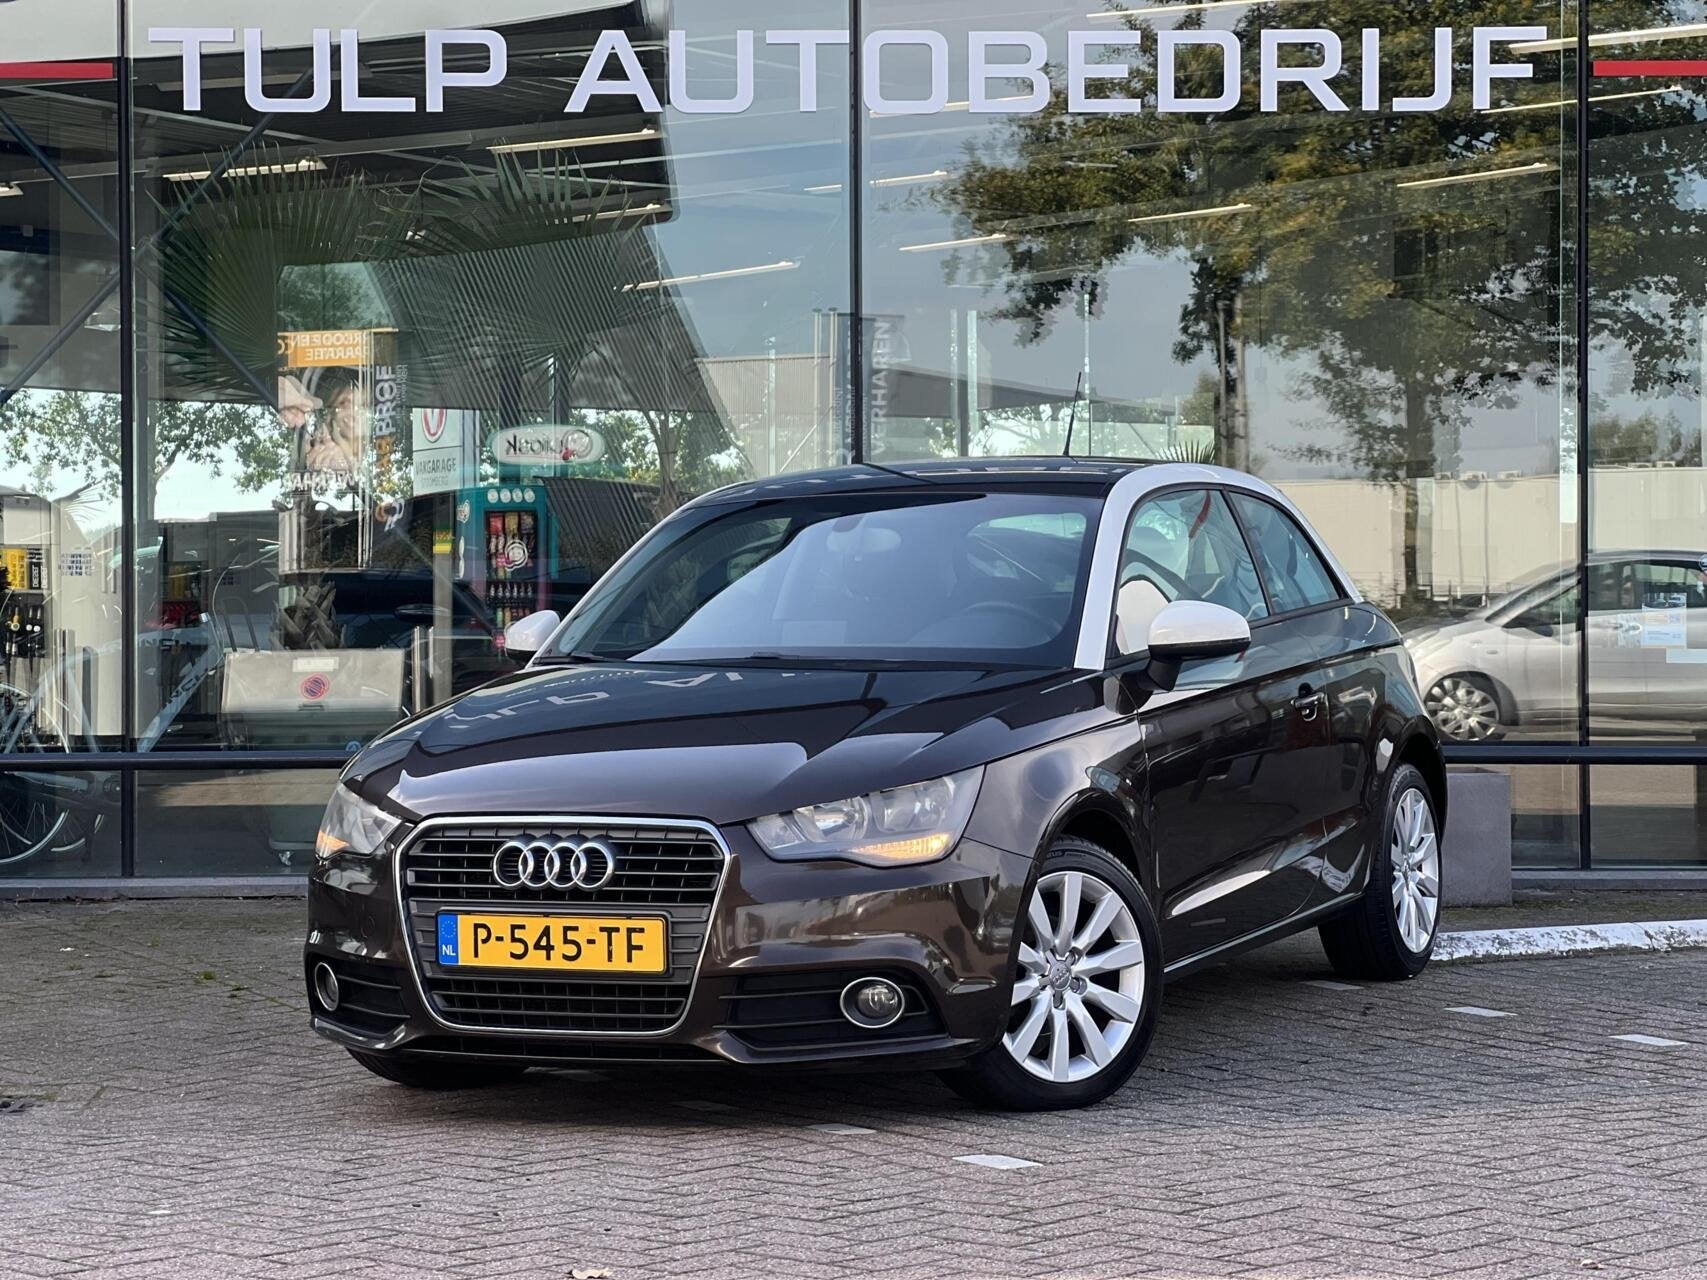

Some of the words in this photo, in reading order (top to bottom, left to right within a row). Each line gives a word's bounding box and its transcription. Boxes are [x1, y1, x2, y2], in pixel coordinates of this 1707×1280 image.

[148, 27, 508, 113] TULP
[564, 26, 1548, 114] AUTOBEDRIJF
[441, 944, 456, 957] NL
[472, 922, 645, 963] P-545-TF
